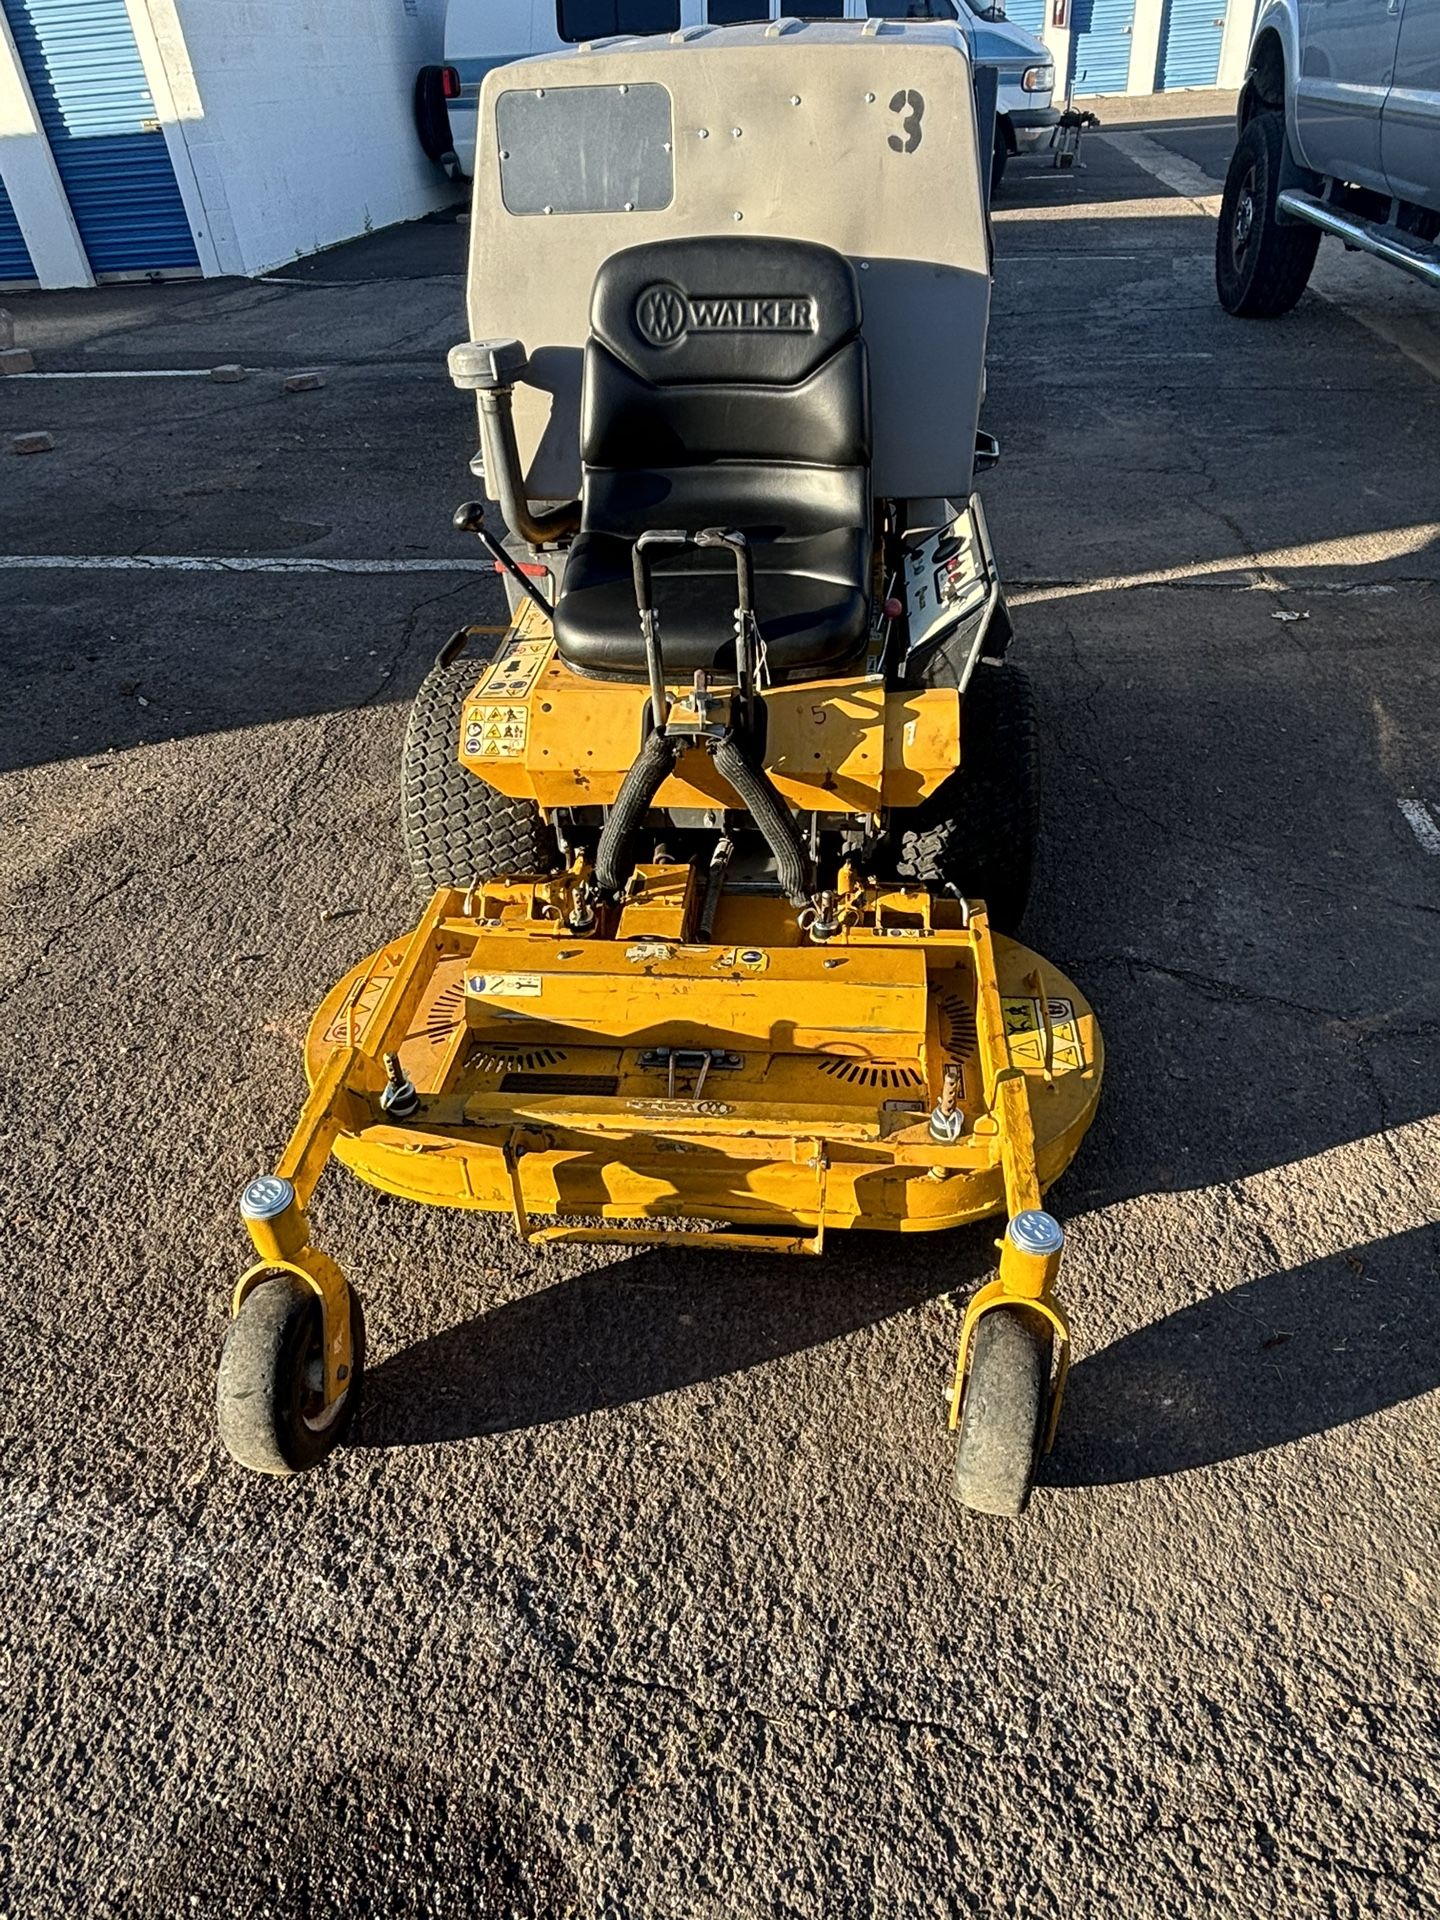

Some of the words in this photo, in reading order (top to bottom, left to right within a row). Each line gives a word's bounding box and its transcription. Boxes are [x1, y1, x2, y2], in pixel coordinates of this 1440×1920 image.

[887, 88, 925, 154] 3
[688, 300, 814, 327] WALKER
[810, 704, 828, 725] 5
